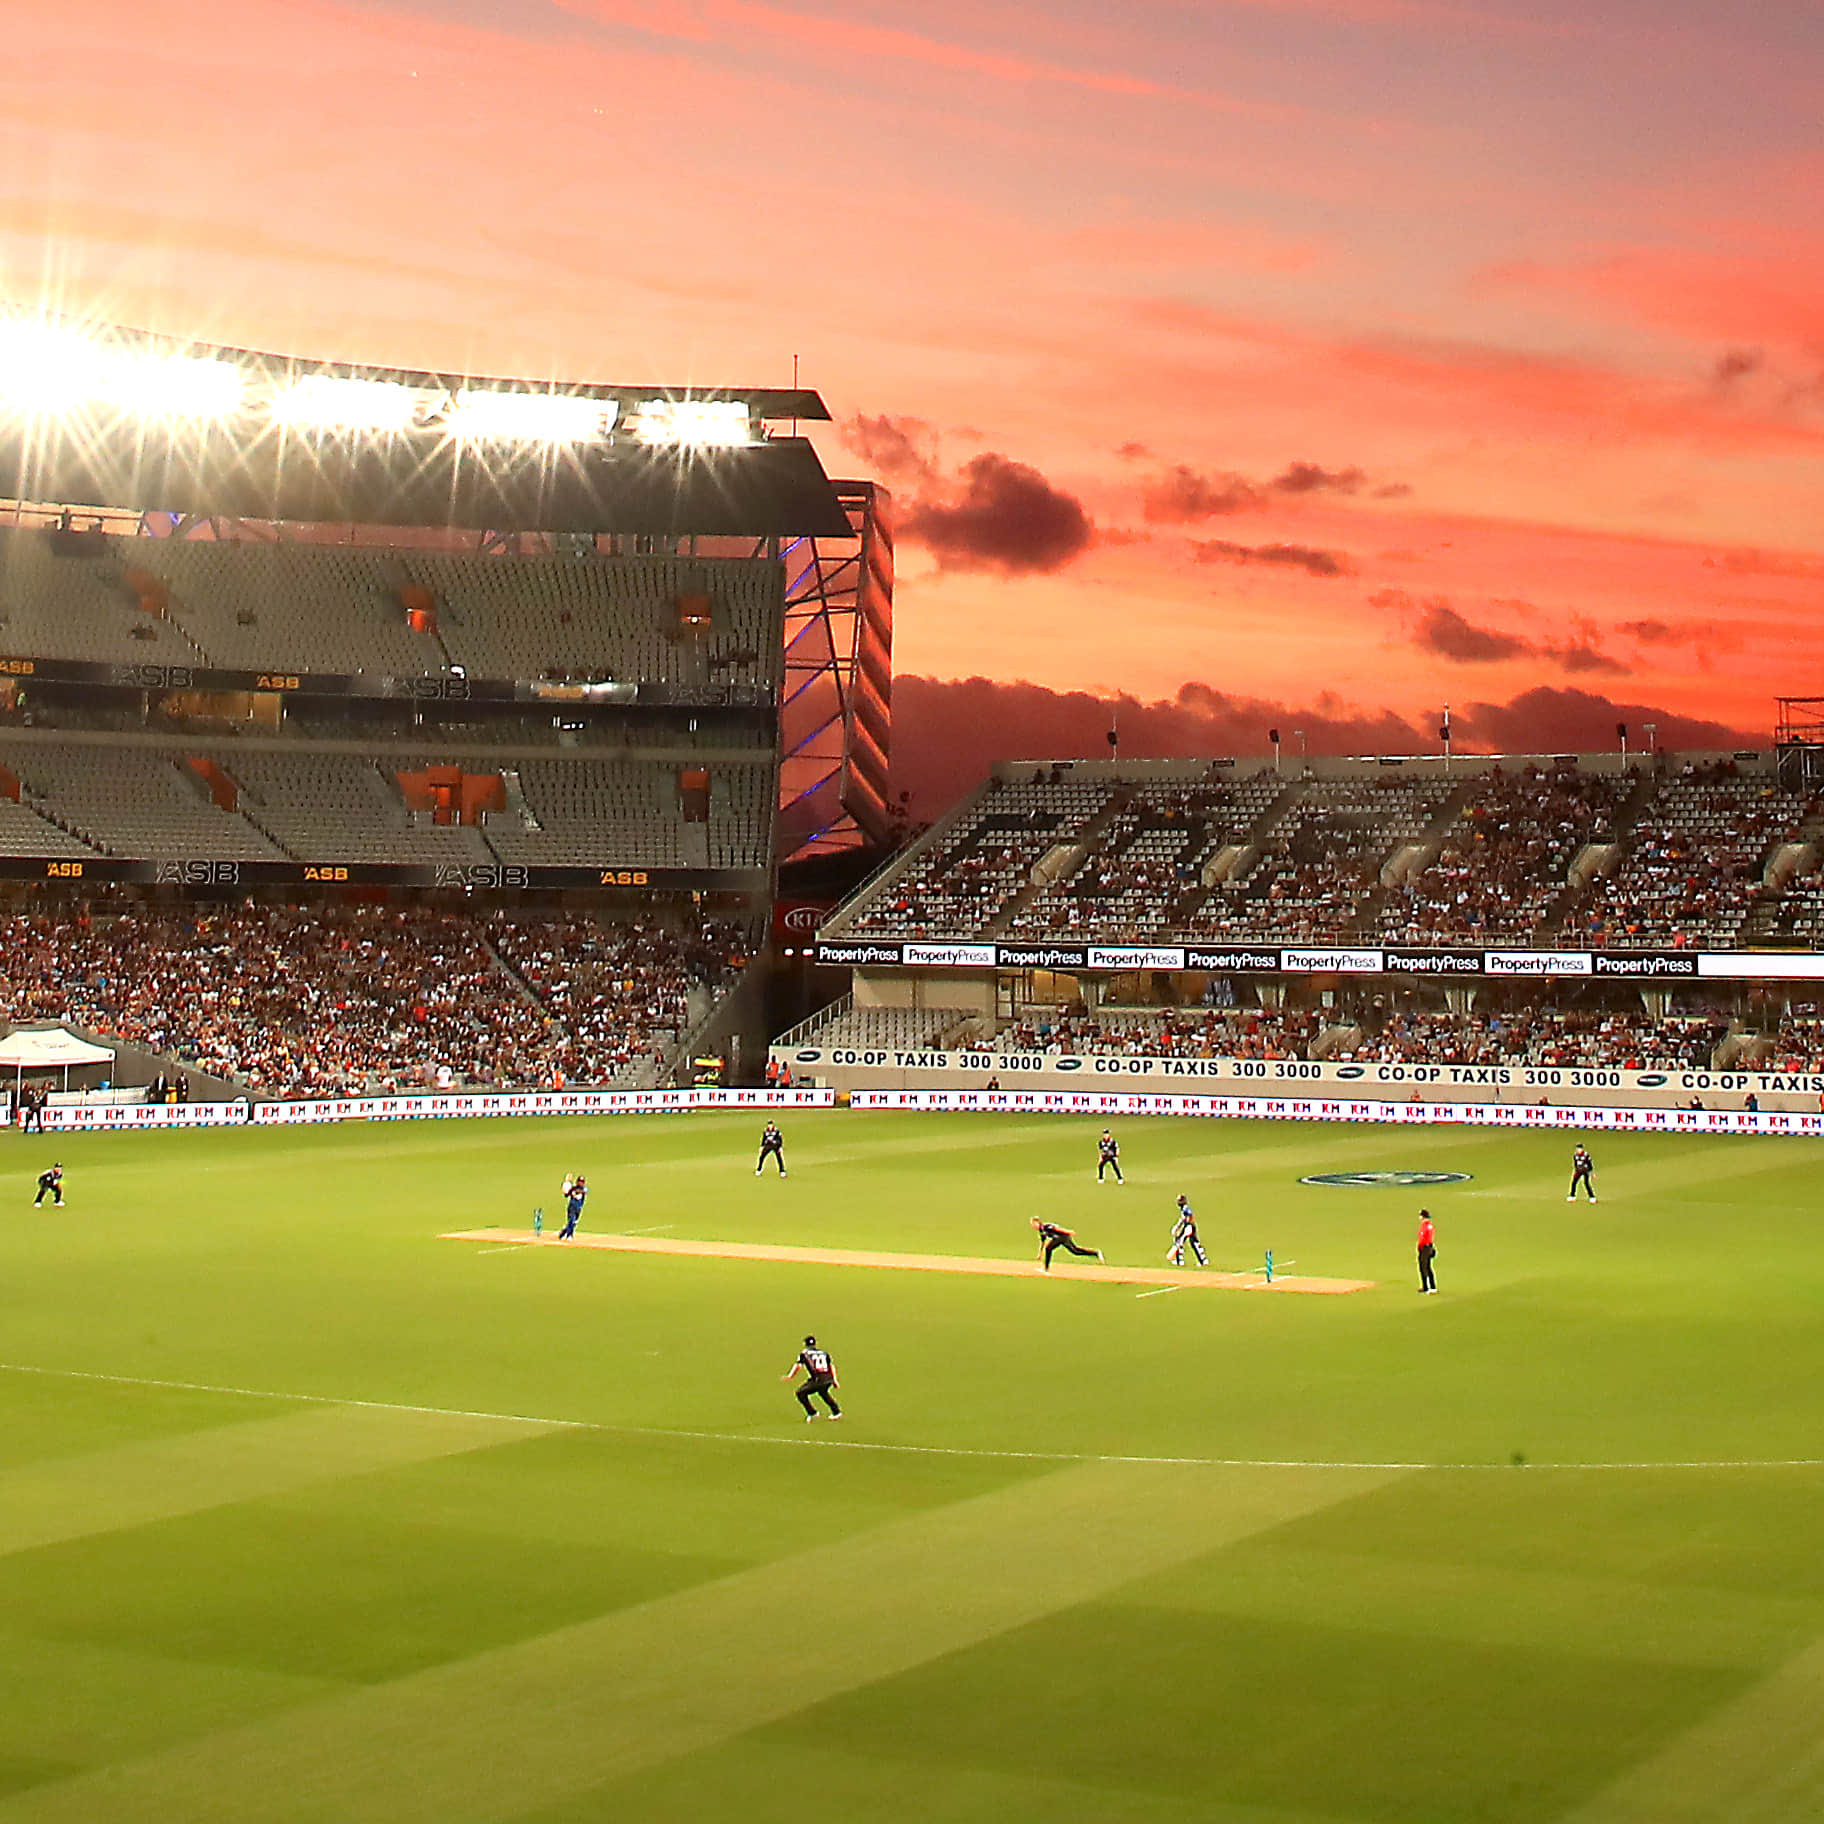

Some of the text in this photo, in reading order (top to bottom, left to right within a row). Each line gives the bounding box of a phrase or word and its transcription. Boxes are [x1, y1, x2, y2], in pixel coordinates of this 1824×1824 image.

[258, 676, 299, 690] ASB
[47, 862, 83, 878] ASB
[305, 868, 349, 881] ASB
[600, 871, 649, 886] ASB
[819, 947, 1693, 974] PropertyPress PropertyPress PropertyPress PropertyPress PropertyPress PropertyPress PropertyPress PropertyPress PropertyPress
[832, 1050, 1043, 1071] CO-OP TAXIS 300 3000
[1094, 1059, 1322, 1079] CO-OP TAXIS 300 3000
[1378, 1066, 1621, 1087] CO-OP TAXIS 300 3000
[1681, 1074, 1749, 1090] CO-OP
[1758, 1076, 1823, 1092] TAXIS
[1613, 1111, 1635, 1124] TCM
